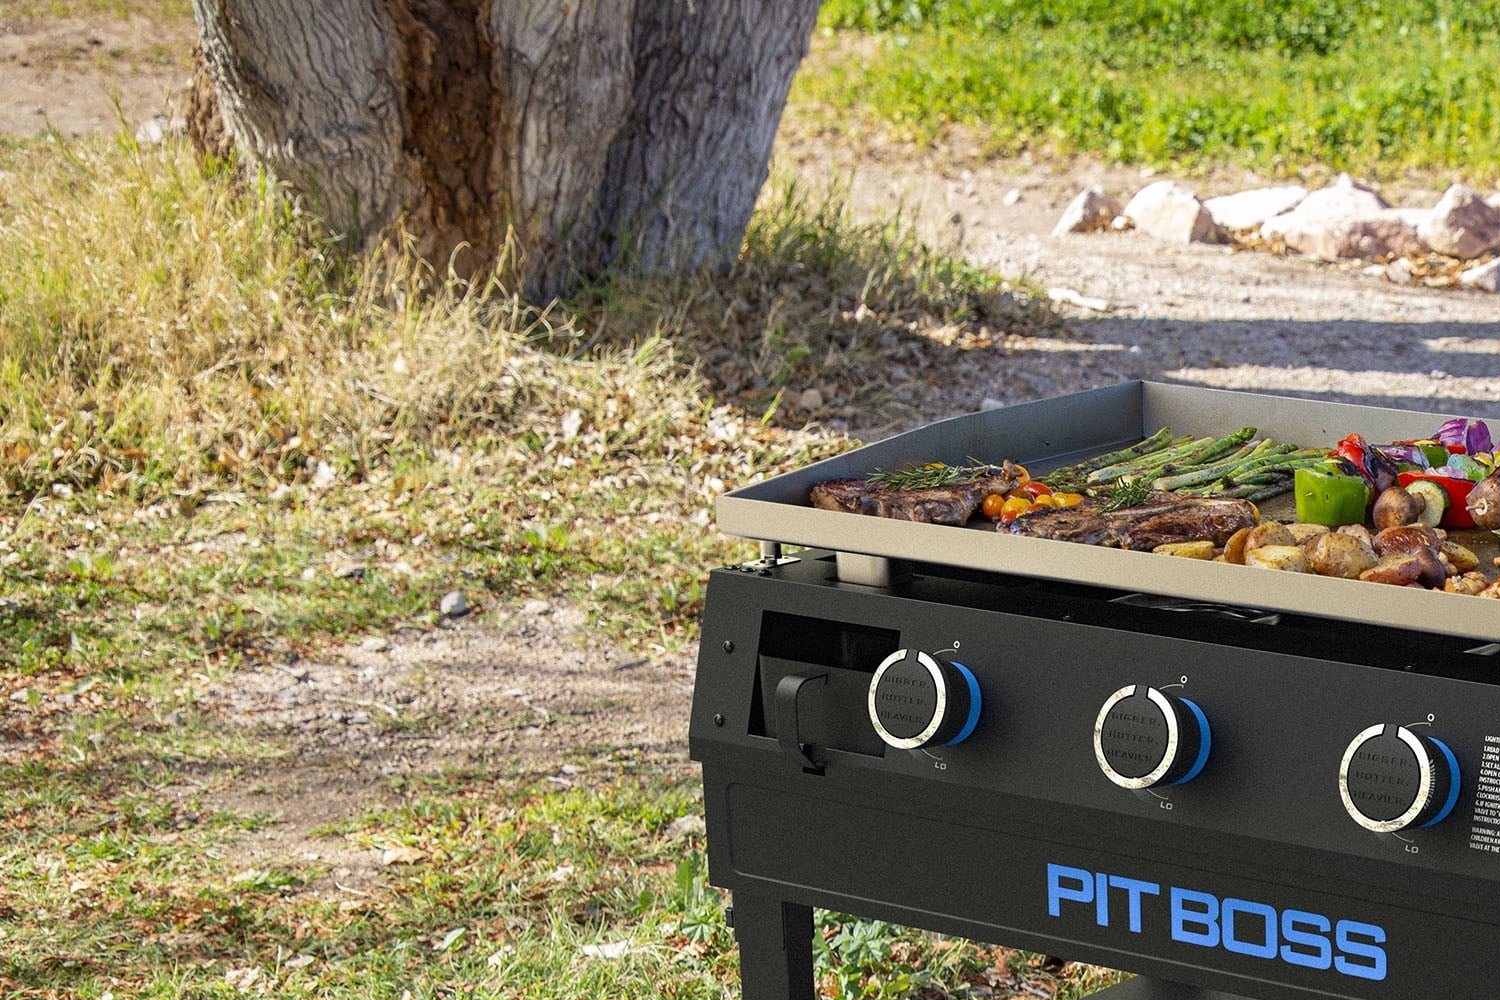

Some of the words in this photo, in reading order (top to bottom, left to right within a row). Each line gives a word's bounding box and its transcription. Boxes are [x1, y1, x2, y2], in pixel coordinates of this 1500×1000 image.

[1474, 807, 1488, 815] VALVE
[1470, 834, 1494, 843] CHILDREN
[1469, 841, 1483, 850] VALVE
[1491, 845, 1499, 853] THE
[1047, 862, 1160, 934] PIT
[1170, 886, 1388, 981] BOSS
